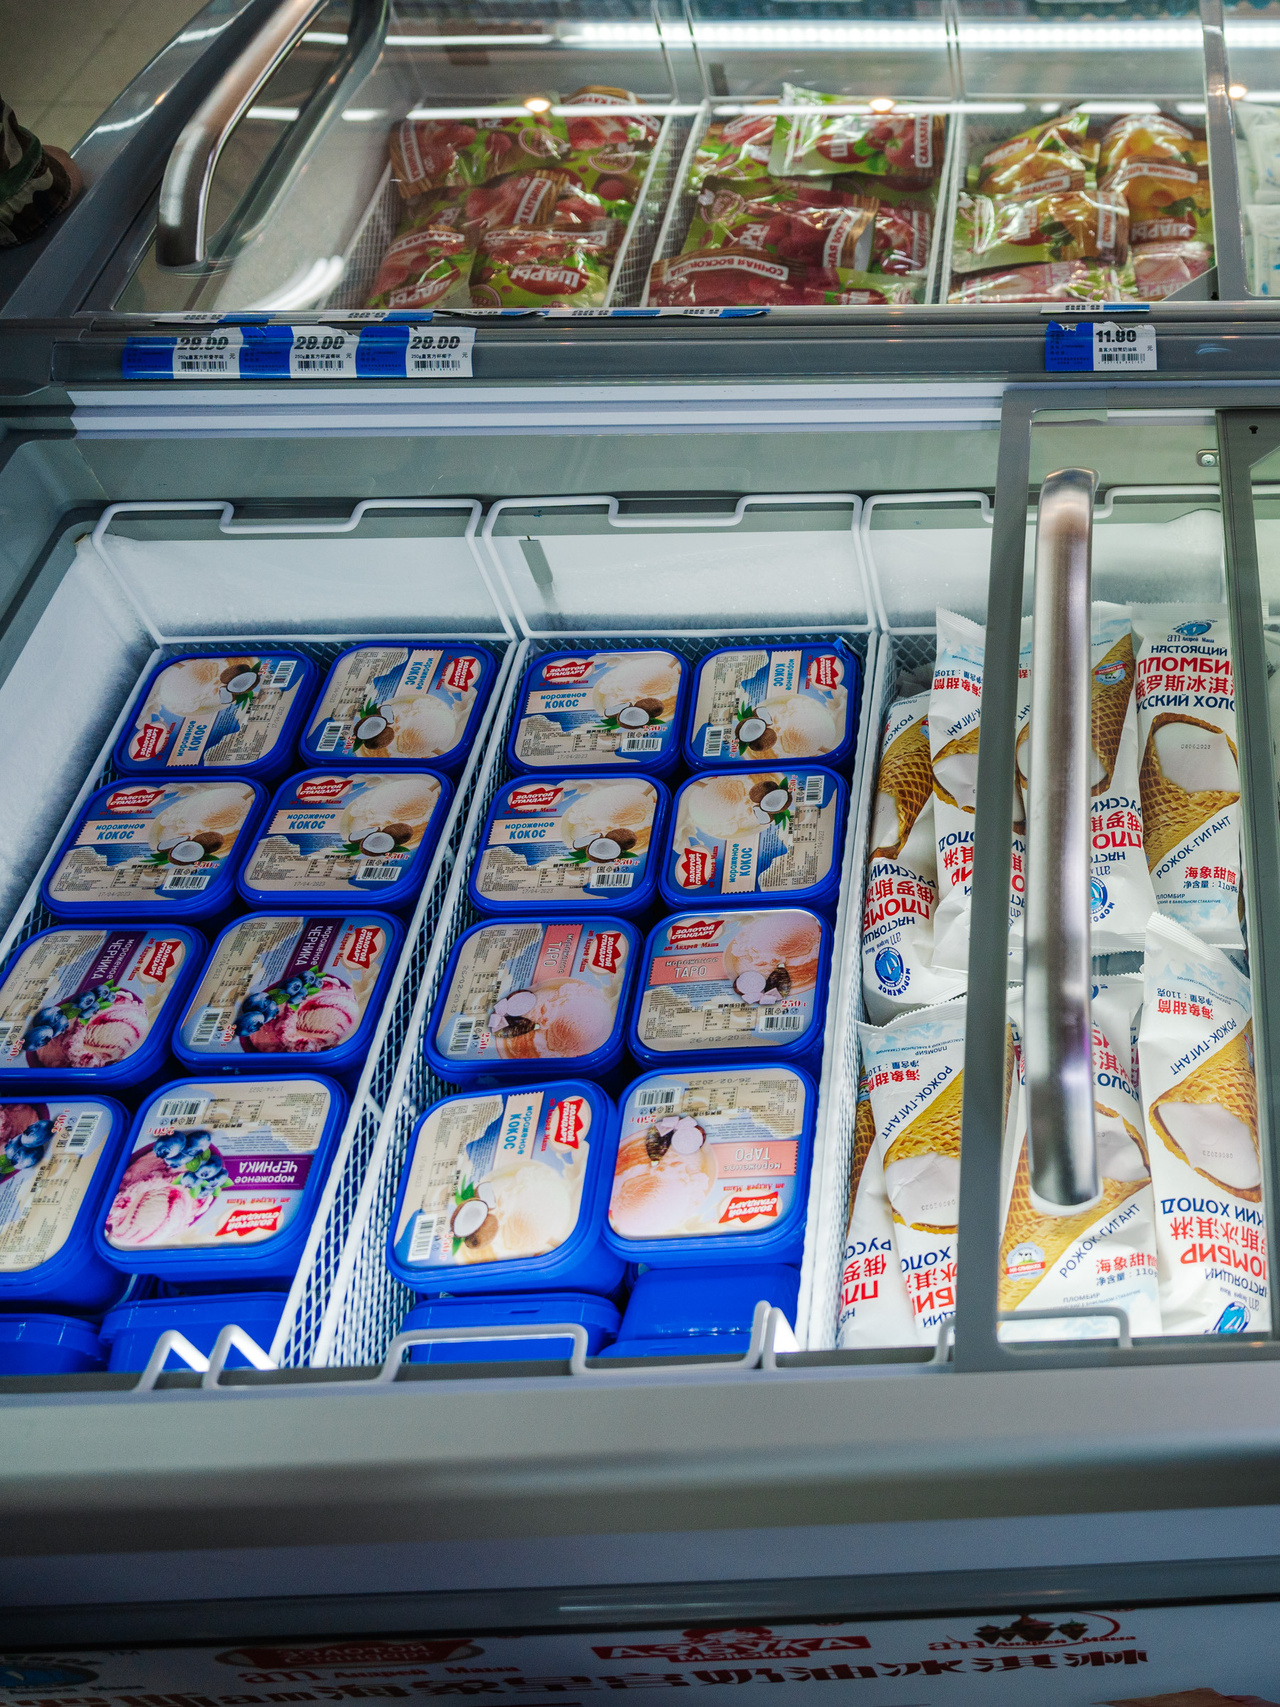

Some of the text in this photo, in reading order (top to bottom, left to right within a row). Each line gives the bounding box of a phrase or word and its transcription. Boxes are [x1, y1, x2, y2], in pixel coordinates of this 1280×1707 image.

[177, 337, 228, 350] 28.00
[294, 336, 344, 349] 28.00
[410, 336, 460, 349] 28.00
[1150, 643, 1228, 657] НАСТОЯЩИЙ
[404, 662, 423, 686] КОКОС
[774, 663, 785, 687] КОКОС
[1138, 657, 1234, 678] ПЛОМБИ
[545, 700, 579, 708] КОКОС
[188, 724, 207, 751] КОКОС
[97, 831, 135, 840] КОКОС
[288, 821, 326, 829] КОКОС
[509, 830, 546, 839] КОКОС
[1155, 814, 1232, 880] РОЖОК-ГИГАНТ
[739, 847, 753, 876] КОКОС
[1184, 866, 1237, 885] 海象甜筒
[295, 926, 324, 966] ЧЕРНИКА
[543, 942, 562, 967] ТАРО
[91, 939, 126, 980] ЧЕРНИКА
[674, 966, 707, 978] ТАРО
[1158, 998, 1214, 1021] 海象甜筒
[1171, 1017, 1237, 1076] РОЖОК-ГИГАНТ
[881, 1065, 953, 1140] РОЖОК-ГИГАНТ
[503, 1113, 522, 1150] КОКОС
[735, 1148, 770, 1161] ТАРО
[238, 1160, 298, 1174] ЧЕРНИКА
[1160, 1198, 1229, 1215] ХОЛОД
[1058, 1203, 1141, 1279] РОЖОК-ГИГАНТ
[609, 1636, 857, 1658] АЗБУКА
